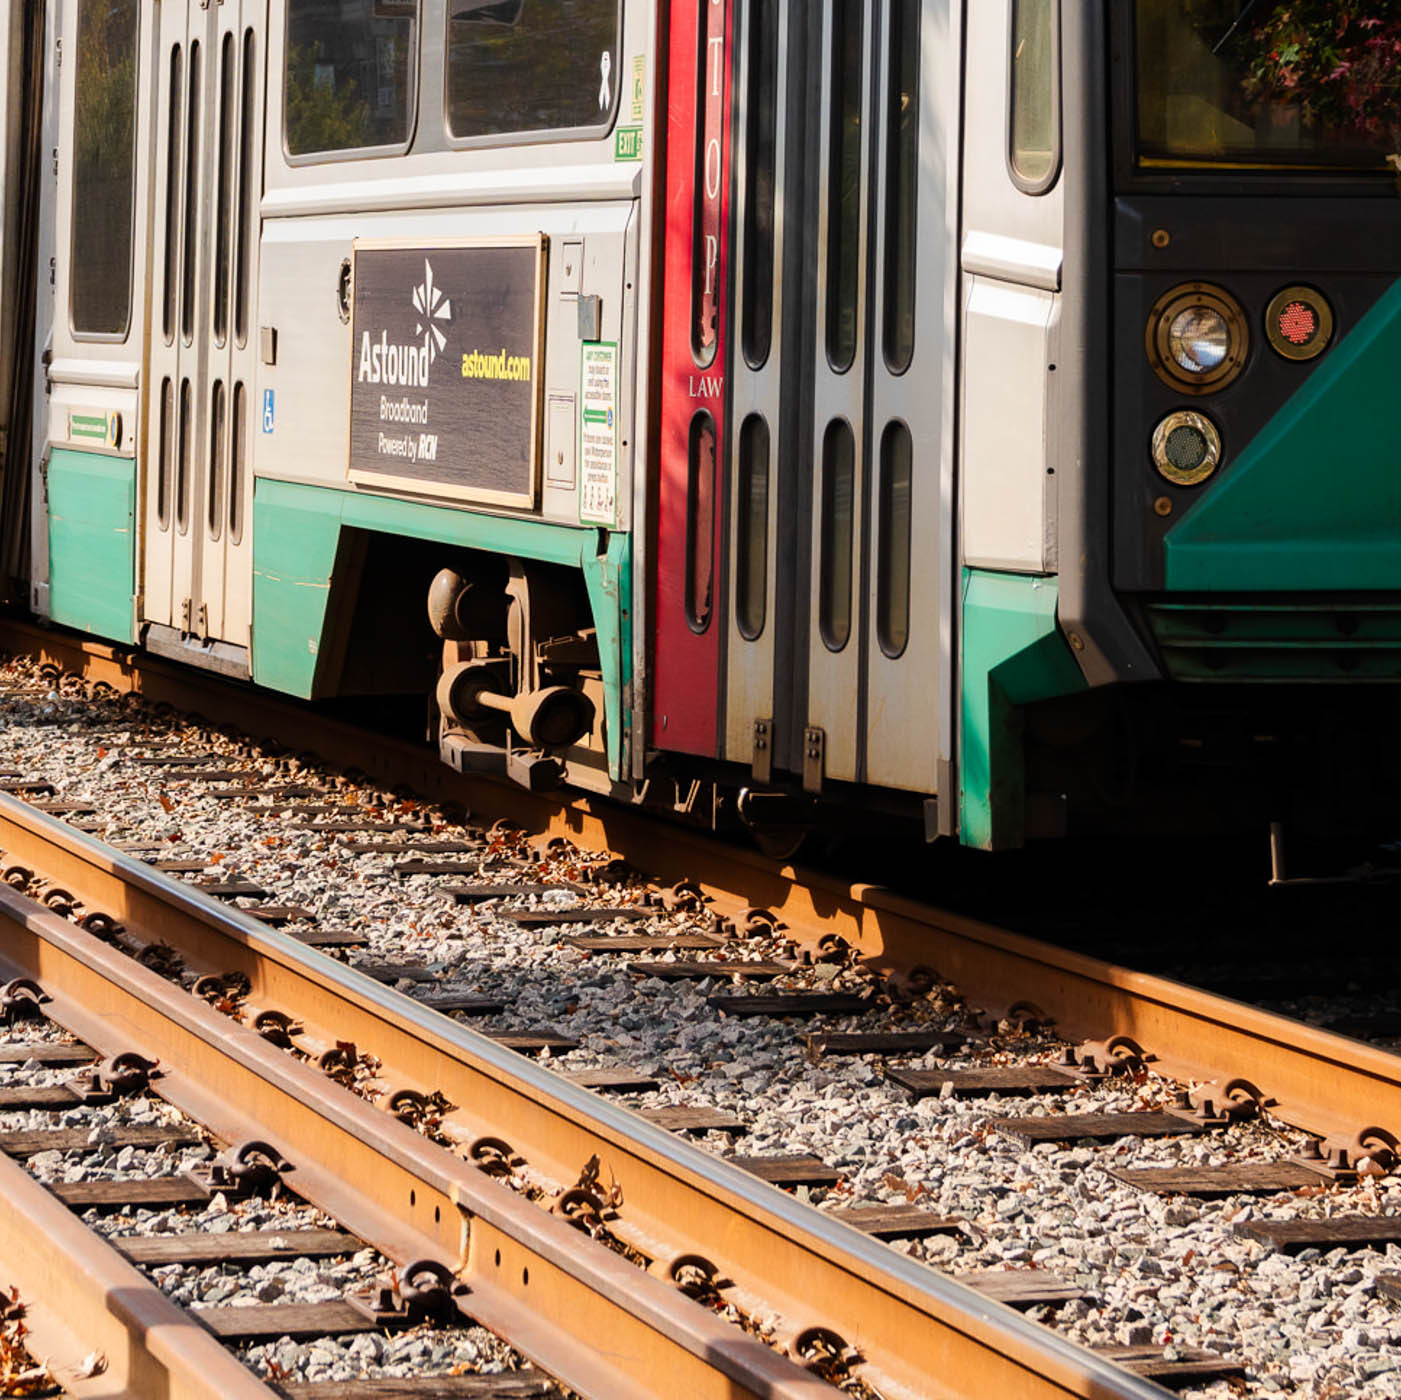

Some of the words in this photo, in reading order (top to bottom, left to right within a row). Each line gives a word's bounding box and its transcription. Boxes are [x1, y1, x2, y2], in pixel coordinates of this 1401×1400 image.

[358, 329, 429, 387] Astound
[461, 348, 531, 381] astound.com
[688, 375, 723, 398] LAW
[380, 395, 428, 424] Broadband
[378, 432, 407, 456] Powered
[407, 436, 418, 463] by
[418, 434, 438, 460] RCN
